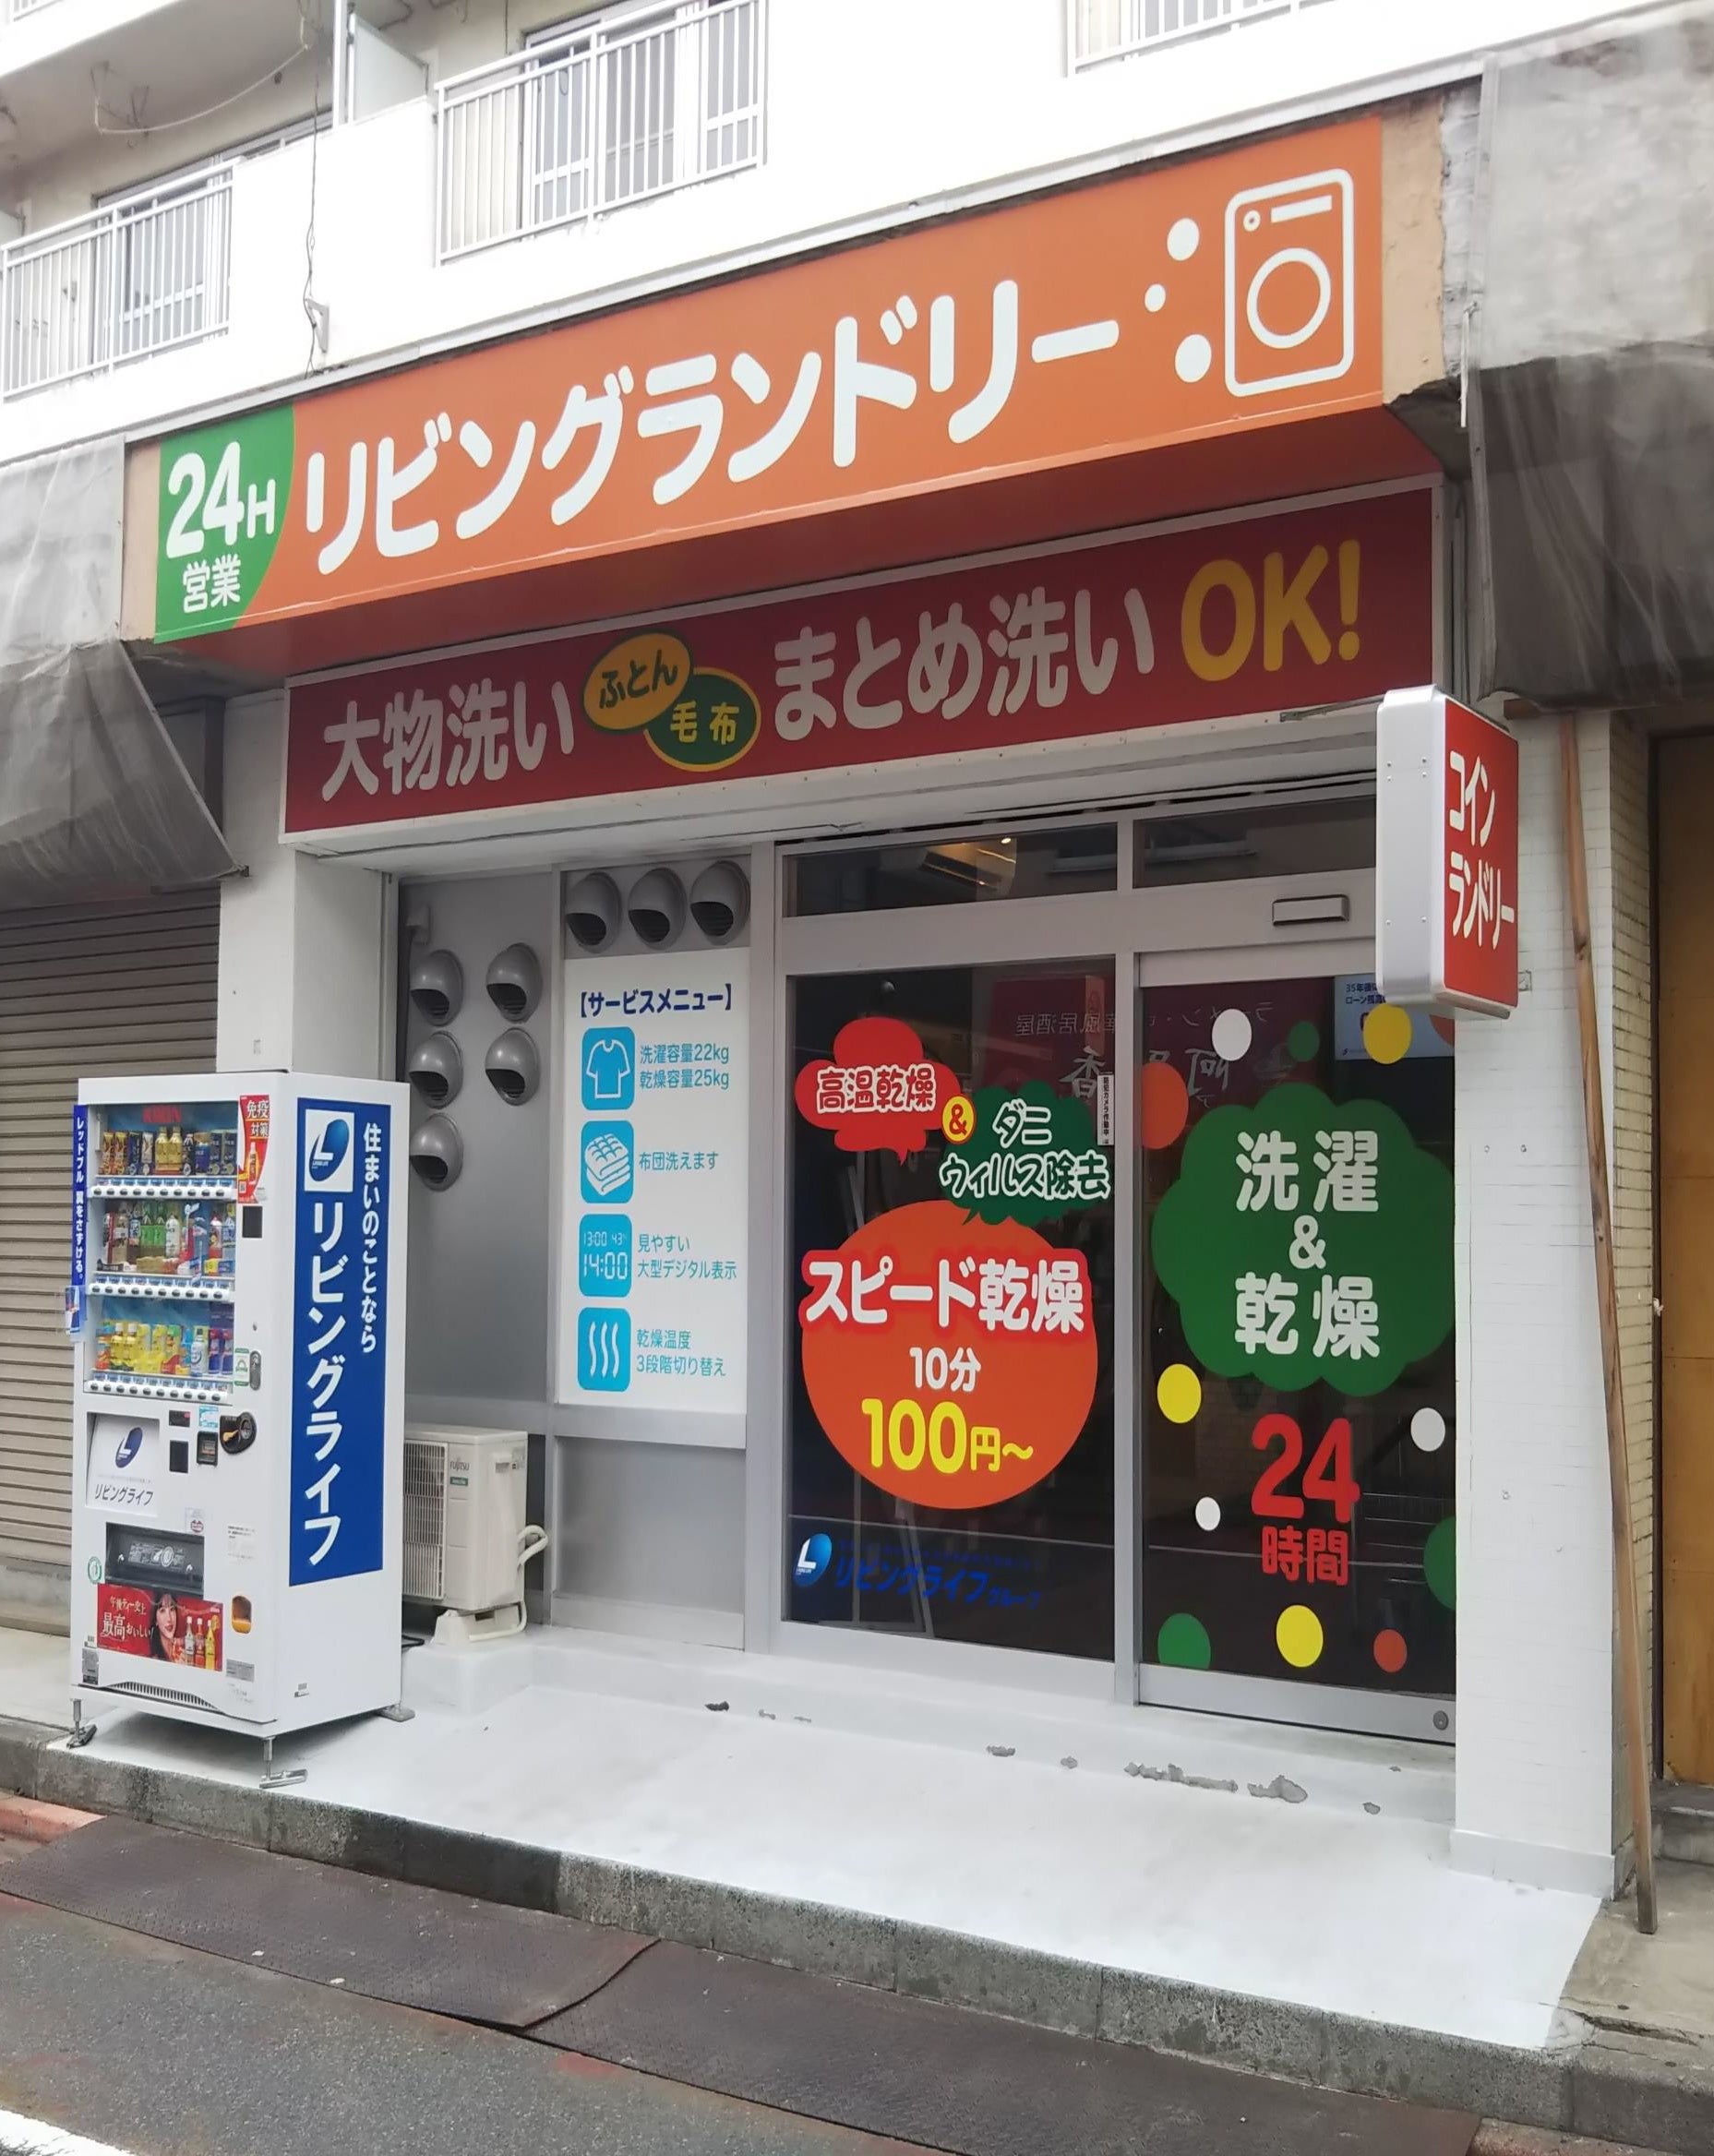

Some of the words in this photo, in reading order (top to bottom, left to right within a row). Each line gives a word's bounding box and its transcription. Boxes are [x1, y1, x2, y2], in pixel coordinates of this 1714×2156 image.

[306, 279, 1120, 575] リビングランドリー
[166, 441, 276, 560] 24H
[183, 554, 242, 614] 営業
[599, 649, 678, 709] ふとん
[321, 677, 575, 802] 大物洗い
[670, 701, 739, 745] 毛布
[1449, 750, 1495, 847] コイン
[1449, 851, 1515, 950] ランドリー
[638, 1042, 730, 1065] 洗濯容量22kg
[638, 1068, 730, 1091] 乾燥容量25kg
[816, 1063, 937, 1114] 高温乾燥
[247, 1099, 270, 1119] 免疫
[251, 1121, 270, 1138] 対策
[949, 1103, 968, 1135] &
[992, 1098, 1052, 1148] ダニ
[638, 1151, 719, 1171] 布団洗えます
[939, 1149, 1111, 1201] ウィルス除去
[1235, 1130, 1379, 1212] 洗濯
[360, 1121, 383, 1353] 住まいのことなら
[637, 1233, 690, 1253] 見やすい
[1288, 1215, 1326, 1269] &
[583, 1252, 628, 1280] 14:00
[637, 1259, 737, 1281] 大型デジタル表示
[805, 1255, 1085, 1335] スピード乾燥
[1235, 1272, 1380, 1359] 乾燥
[636, 1329, 692, 1350] 乾燥温度
[305, 1202, 349, 1566] リビングライフ
[636, 1354, 726, 1377] 3段階切り替え
[909, 1347, 982, 1393] 10分
[1251, 1413, 1361, 1523] 24
[94, 1483, 154, 1507] リビングライフ
[1262, 1525, 1348, 1586] 時間
